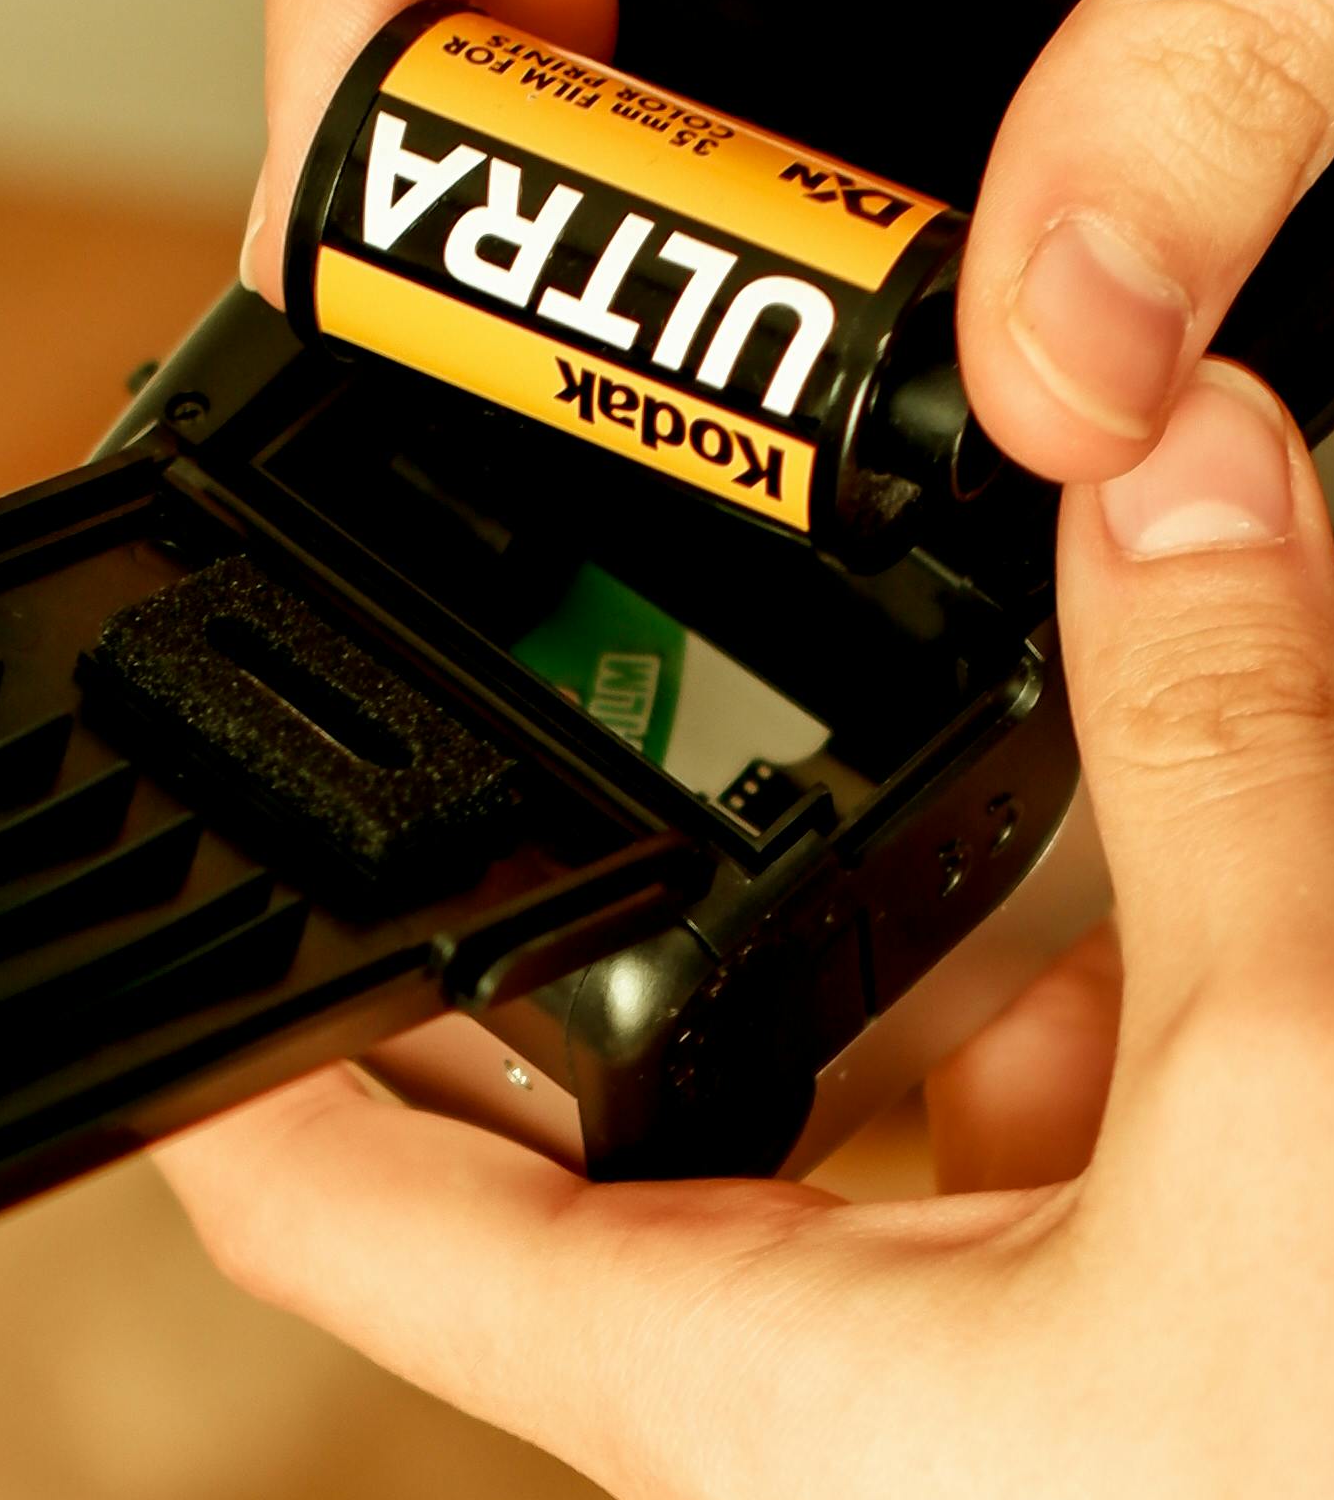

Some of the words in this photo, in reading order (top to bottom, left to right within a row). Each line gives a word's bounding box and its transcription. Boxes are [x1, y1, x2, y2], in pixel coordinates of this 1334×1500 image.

[442, 35, 516, 75] FOR
[488, 34, 608, 88] PRINTS
[520, 67, 601, 110] FILM
[610, 102, 671, 132] mm
[616, 88, 736, 140] COLOR
[669, 129, 720, 156] 35
[361, 110, 835, 418] ULTRA
[555, 356, 785, 501] Kodak
